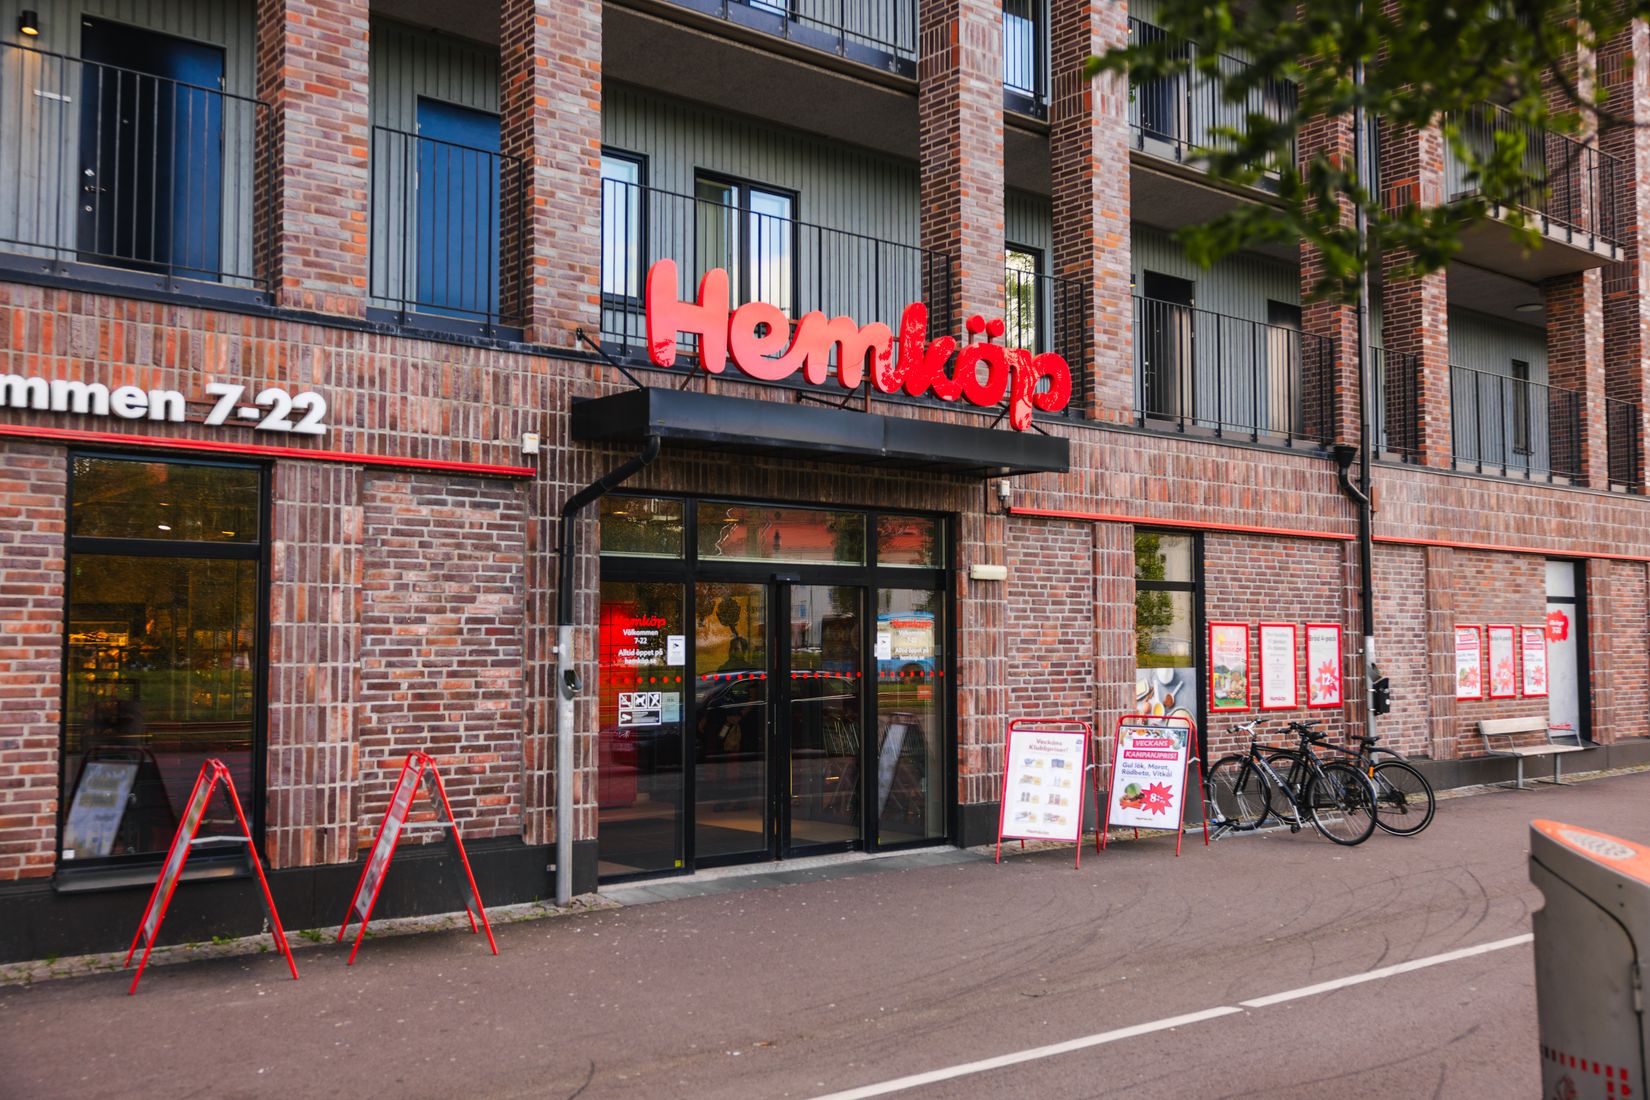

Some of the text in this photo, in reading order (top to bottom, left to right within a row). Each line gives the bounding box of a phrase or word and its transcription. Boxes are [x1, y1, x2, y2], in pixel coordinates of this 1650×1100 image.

[646, 258, 1072, 431] Hemköp
[204, 382, 327, 434] 7-22
[1125, 751, 1178, 760] KAMPANJPRIS!
[1135, 740, 1169, 748] VECKANS
